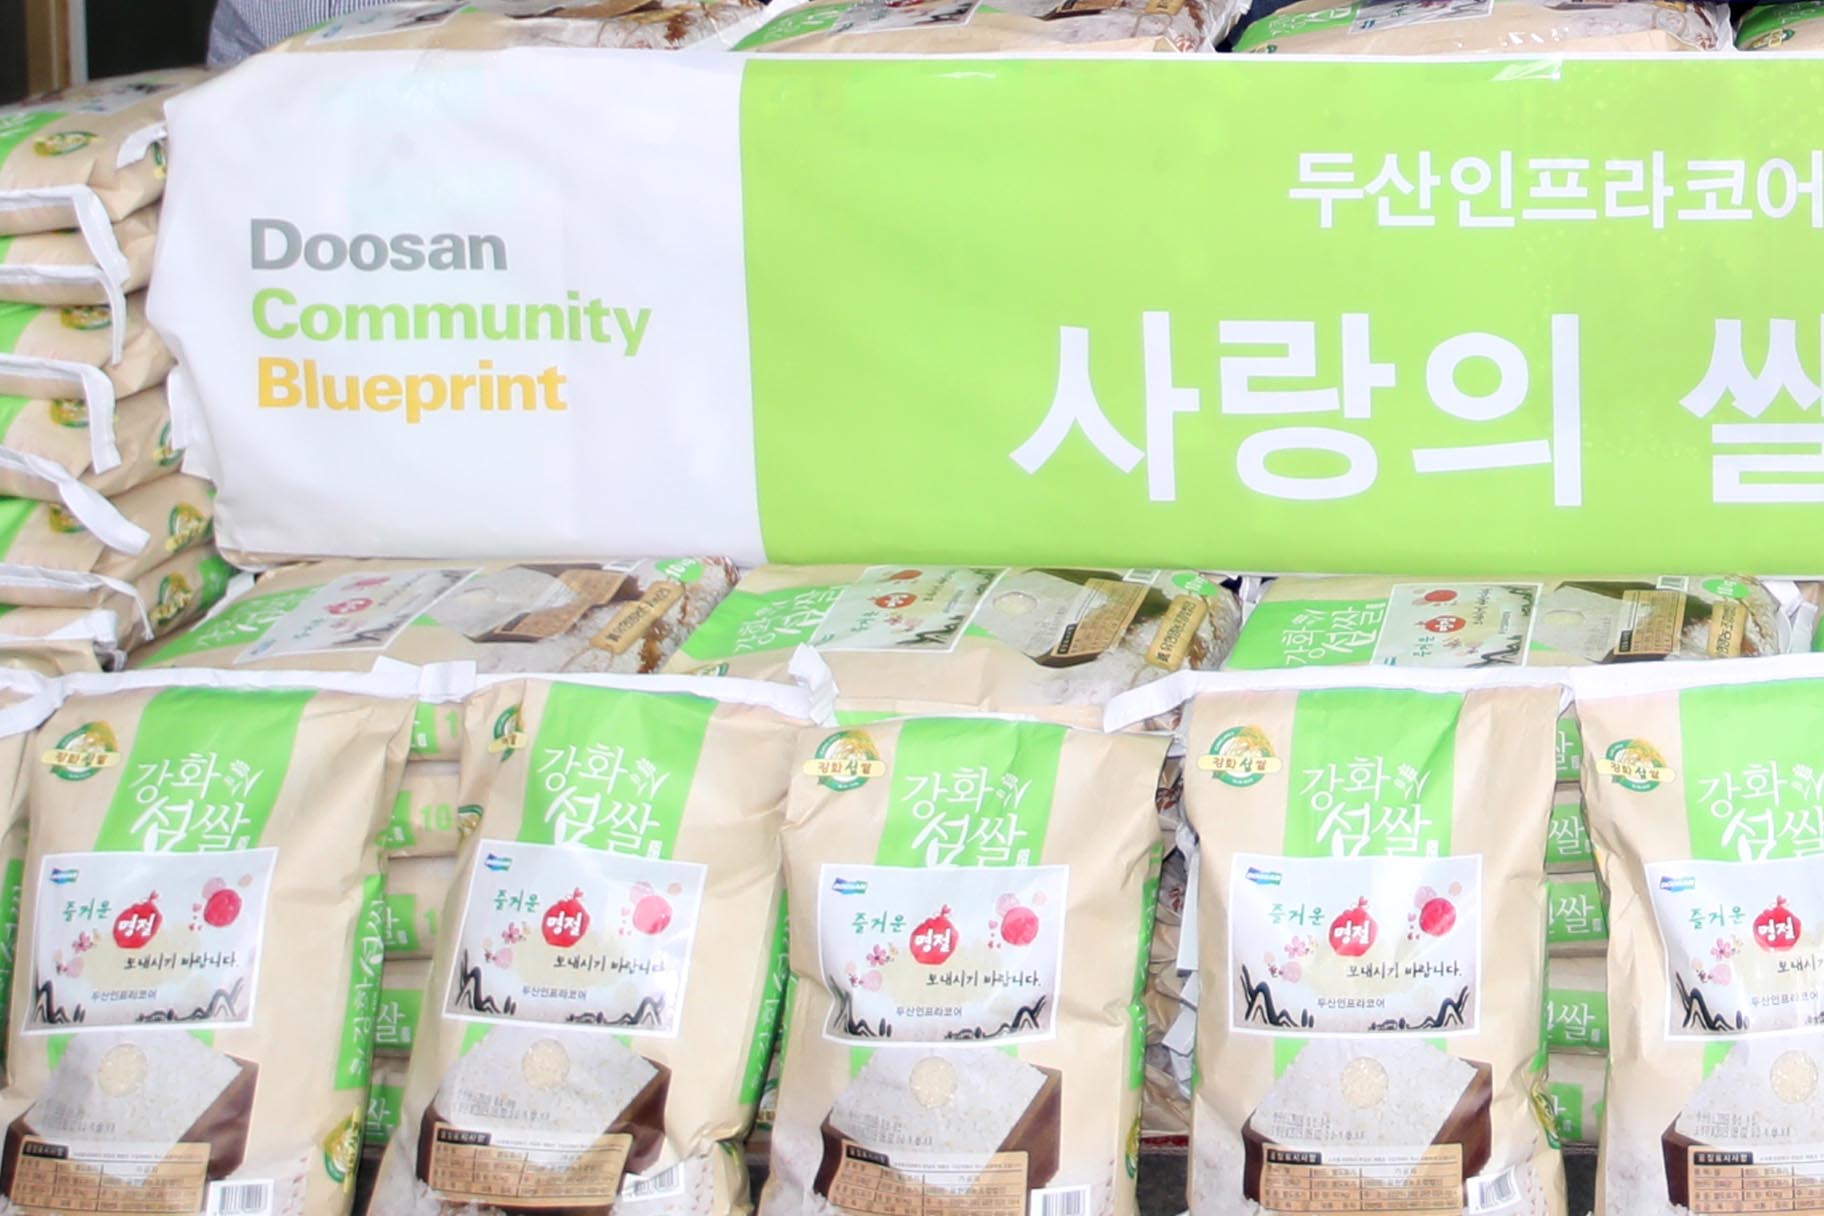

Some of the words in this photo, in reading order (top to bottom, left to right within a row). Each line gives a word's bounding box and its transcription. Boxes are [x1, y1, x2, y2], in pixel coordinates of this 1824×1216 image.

[250, 218, 508, 272] Doosan
[251, 288, 653, 358] Community
[257, 356, 568, 424] Blueprint
[1008, 310, 1582, 507] 사랑의
[128, 752, 221, 804] 강화
[538, 742, 630, 794] 강화
[903, 766, 997, 820] 강화
[1299, 755, 1392, 811] 강화
[1697, 760, 1789, 818] 강화
[131, 796, 251, 854] 섬쌀
[543, 786, 663, 858] 섬쌀
[911, 810, 1028, 867] 섬쌀
[1315, 801, 1433, 857] 섬쌀
[62, 898, 112, 922] 즐거운
[118, 913, 157, 938] 명절
[493, 888, 540, 913] 즐거운
[546, 912, 584, 938] 명절
[851, 910, 907, 935] 즐거운
[914, 928, 953, 954] 명절
[1268, 902, 1326, 926] 즐거운
[1333, 919, 1371, 944] 명절
[1688, 906, 1746, 929] 즐거운
[1756, 916, 1797, 943] 명절
[124, 950, 177, 971] 보내시기
[553, 955, 607, 973] 보내시기
[926, 970, 979, 988] 보내시기
[1346, 961, 1399, 979] 보내시기
